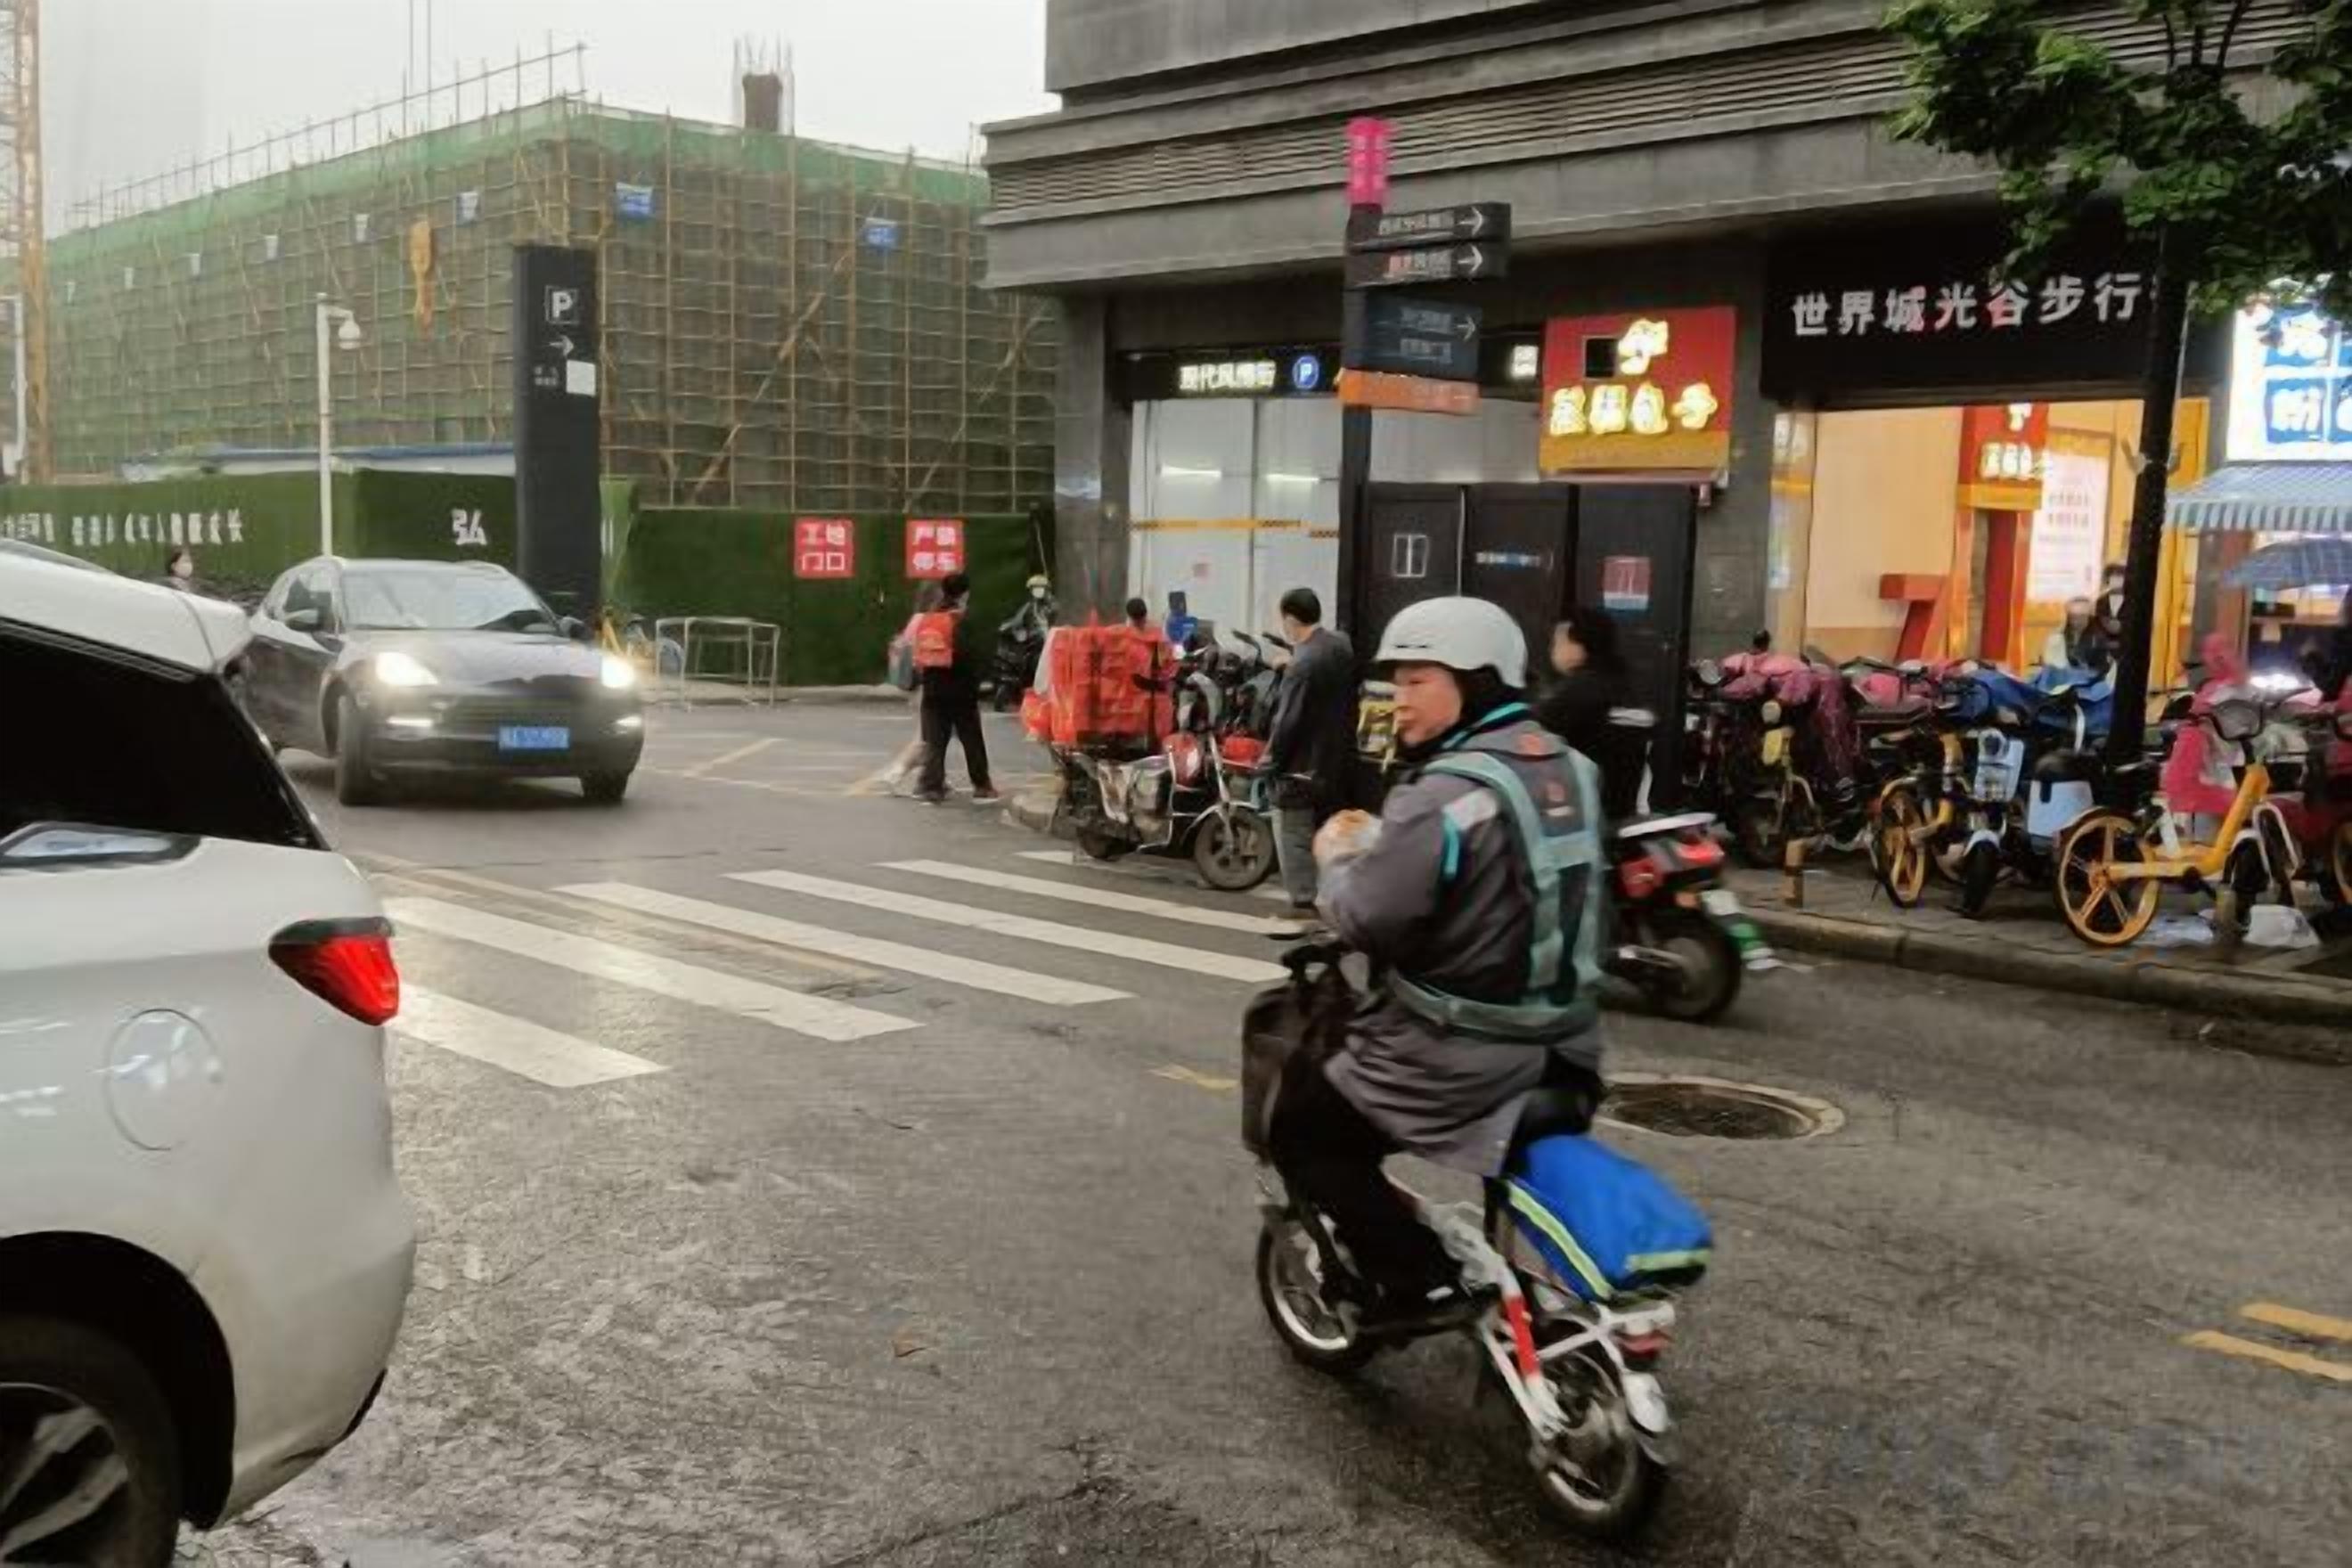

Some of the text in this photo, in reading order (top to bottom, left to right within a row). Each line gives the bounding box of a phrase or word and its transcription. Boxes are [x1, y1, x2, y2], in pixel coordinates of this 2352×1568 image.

[1792, 273, 2158, 337] 世界城光谷步行
[801, 522, 846, 546] 工地
[801, 551, 846, 572] 门口
